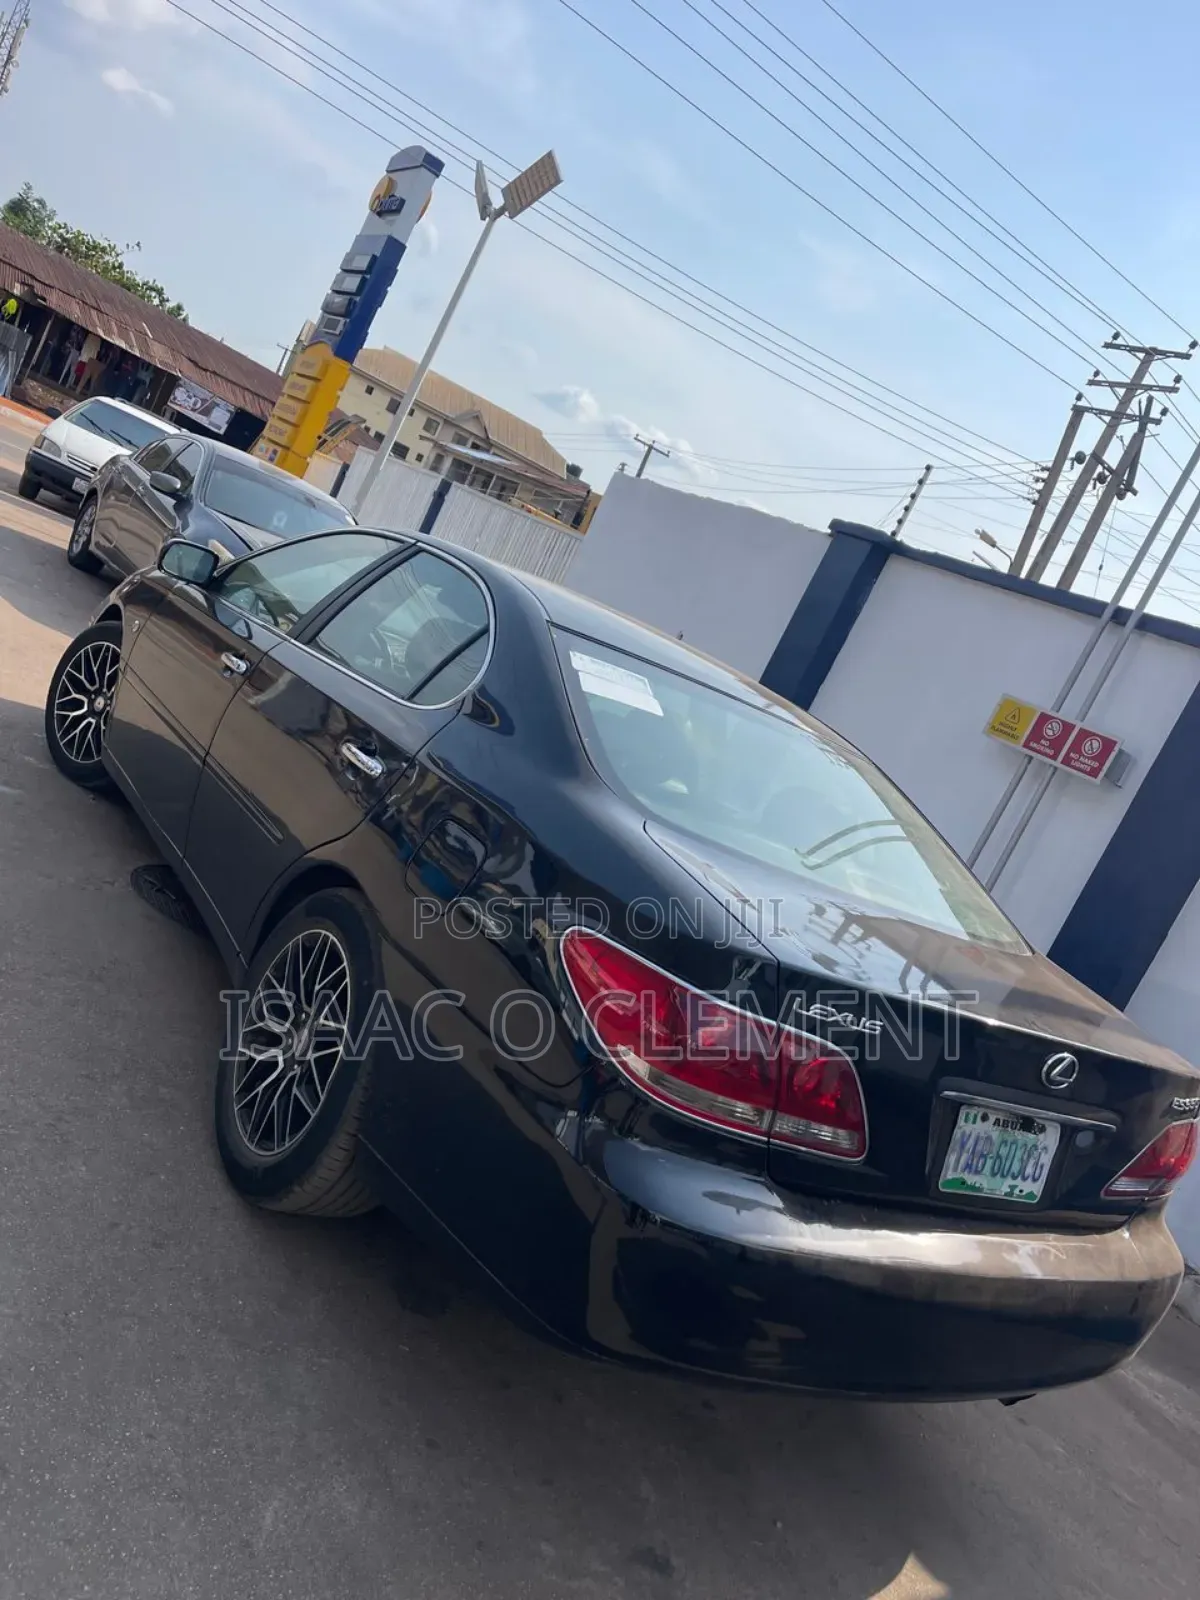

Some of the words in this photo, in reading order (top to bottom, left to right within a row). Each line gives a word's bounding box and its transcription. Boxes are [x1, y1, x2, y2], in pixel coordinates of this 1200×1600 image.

[1029, 741, 1055, 756] SMOKING
[1039, 739, 1050, 747] NO
[1069, 752, 1080, 761] NO
[1079, 756, 1100, 768] NAKED
[1070, 760, 1091, 772] LIGHTS
[793, 997, 884, 1036] LEXUS
